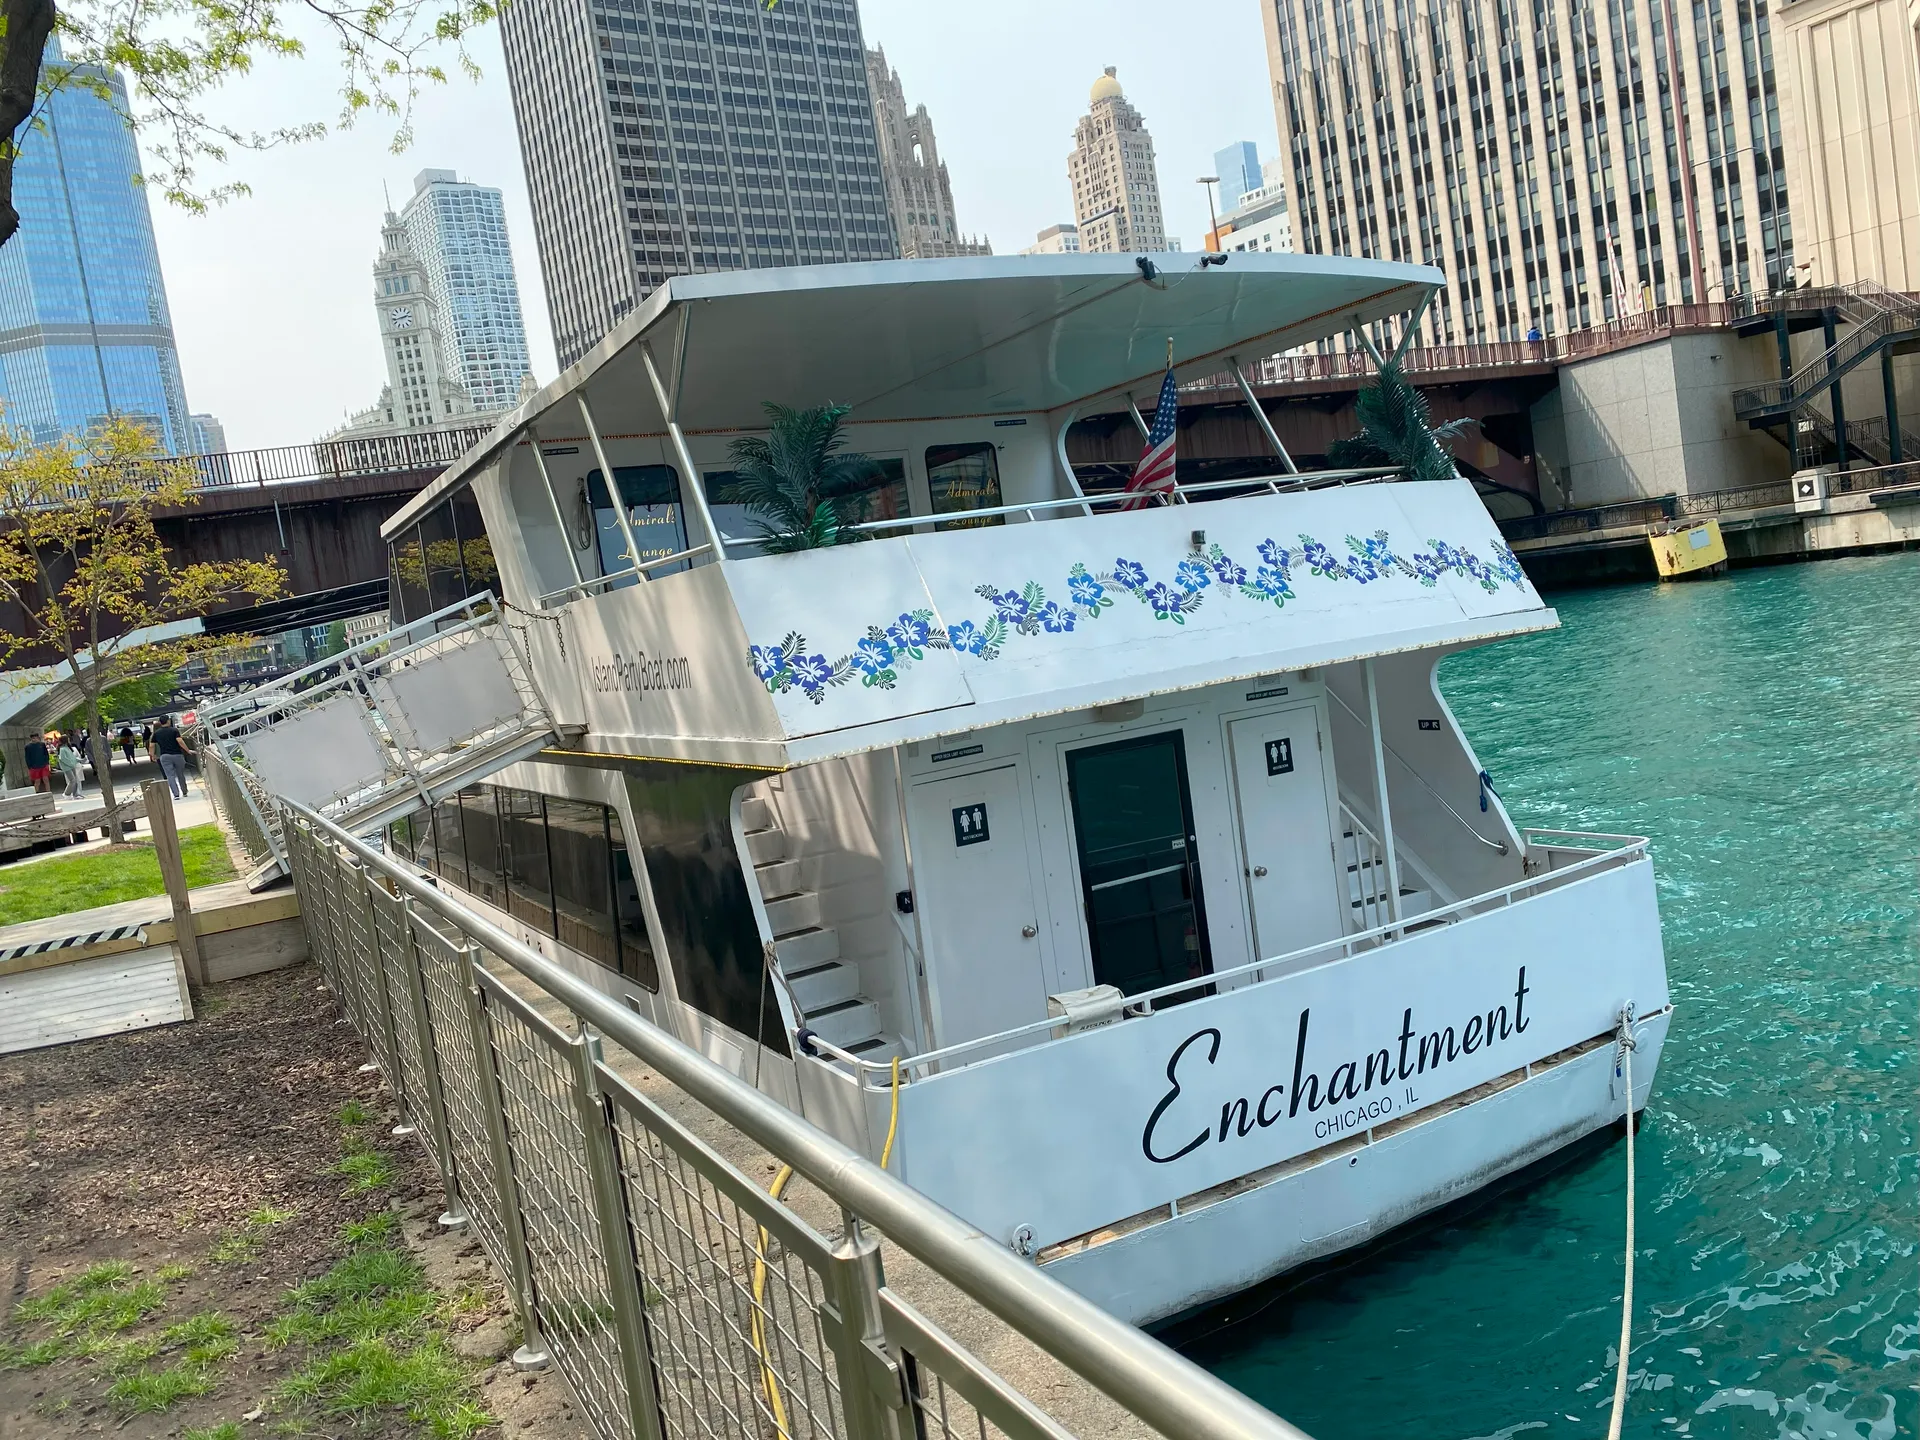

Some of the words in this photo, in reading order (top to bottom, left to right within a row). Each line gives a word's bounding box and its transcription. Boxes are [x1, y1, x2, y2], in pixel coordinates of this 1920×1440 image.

[938, 478, 995, 499] Admiral's
[618, 547, 673, 560] Lunge
[591, 650, 691, 701] IslandPartyBoat.com
[1142, 965, 1530, 1164] Enchantment
[1314, 1096, 1392, 1138] CHICAGO
[1405, 1087, 1419, 1105] IL
